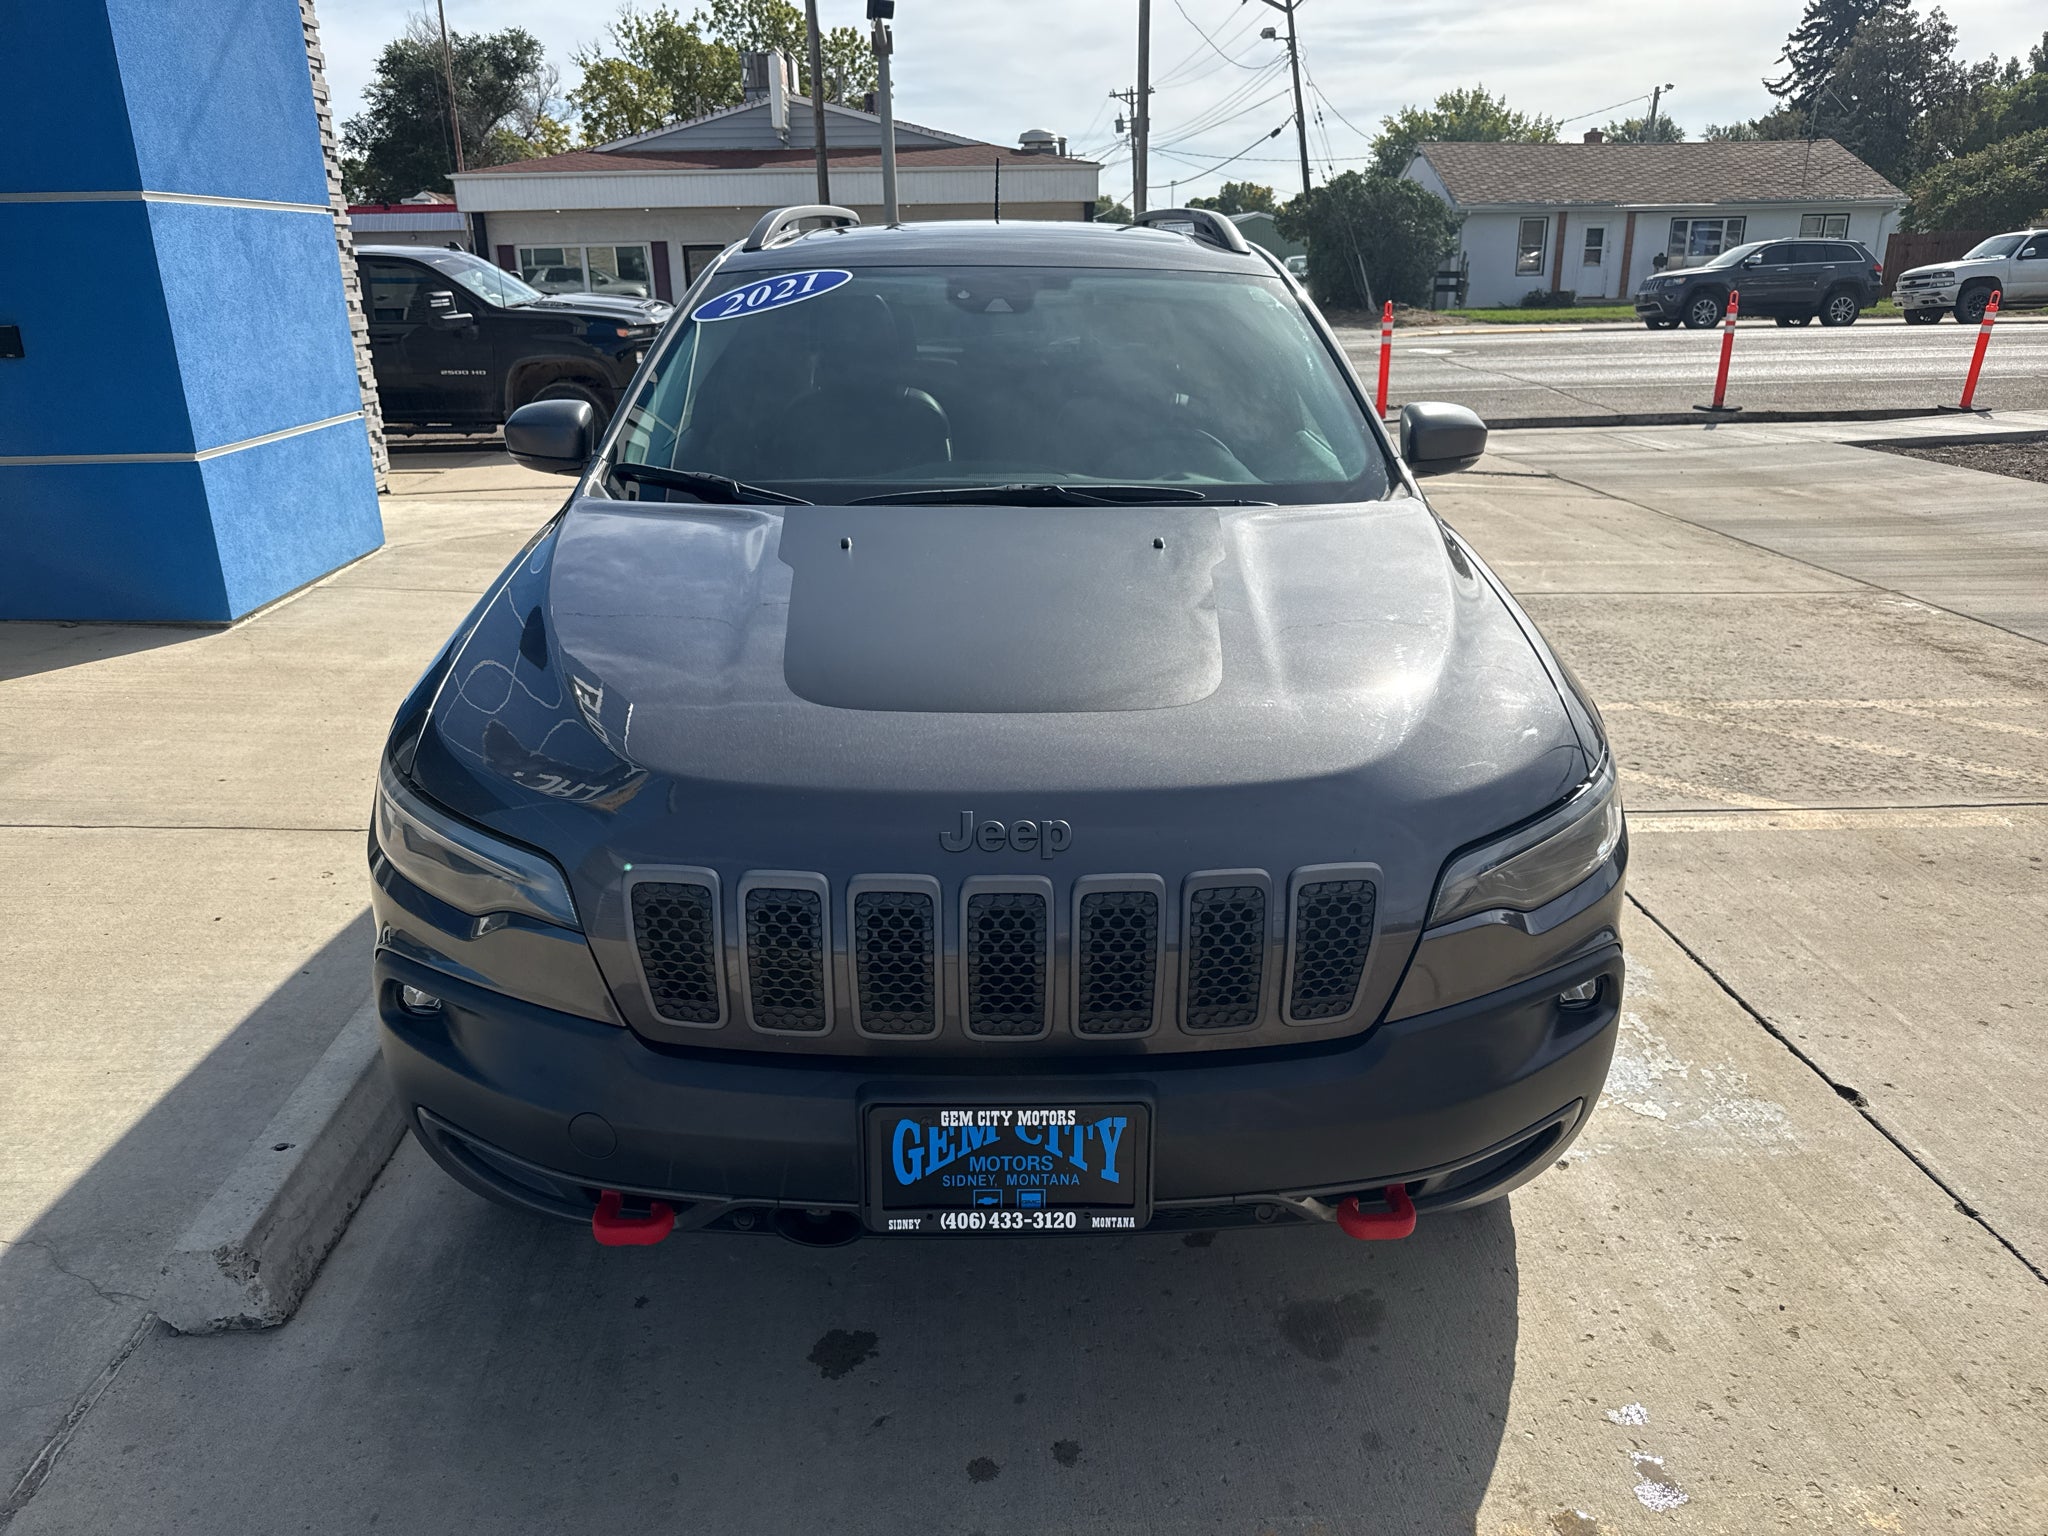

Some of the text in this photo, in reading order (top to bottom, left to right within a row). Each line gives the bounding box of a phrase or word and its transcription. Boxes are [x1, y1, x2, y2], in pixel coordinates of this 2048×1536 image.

[719, 273, 819, 317] 2021
[939, 810, 1073, 860] Jeep
[940, 1109, 1076, 1127] GEM CITY MOTORS
[892, 1118, 1001, 1186] GEM
[969, 1156, 1054, 1172] MOTORS
[1006, 1173, 1080, 1186] MONTANA
[888, 1218, 921, 1230] SIDNEY
[1091, 1216, 1136, 1228] MONTANA
